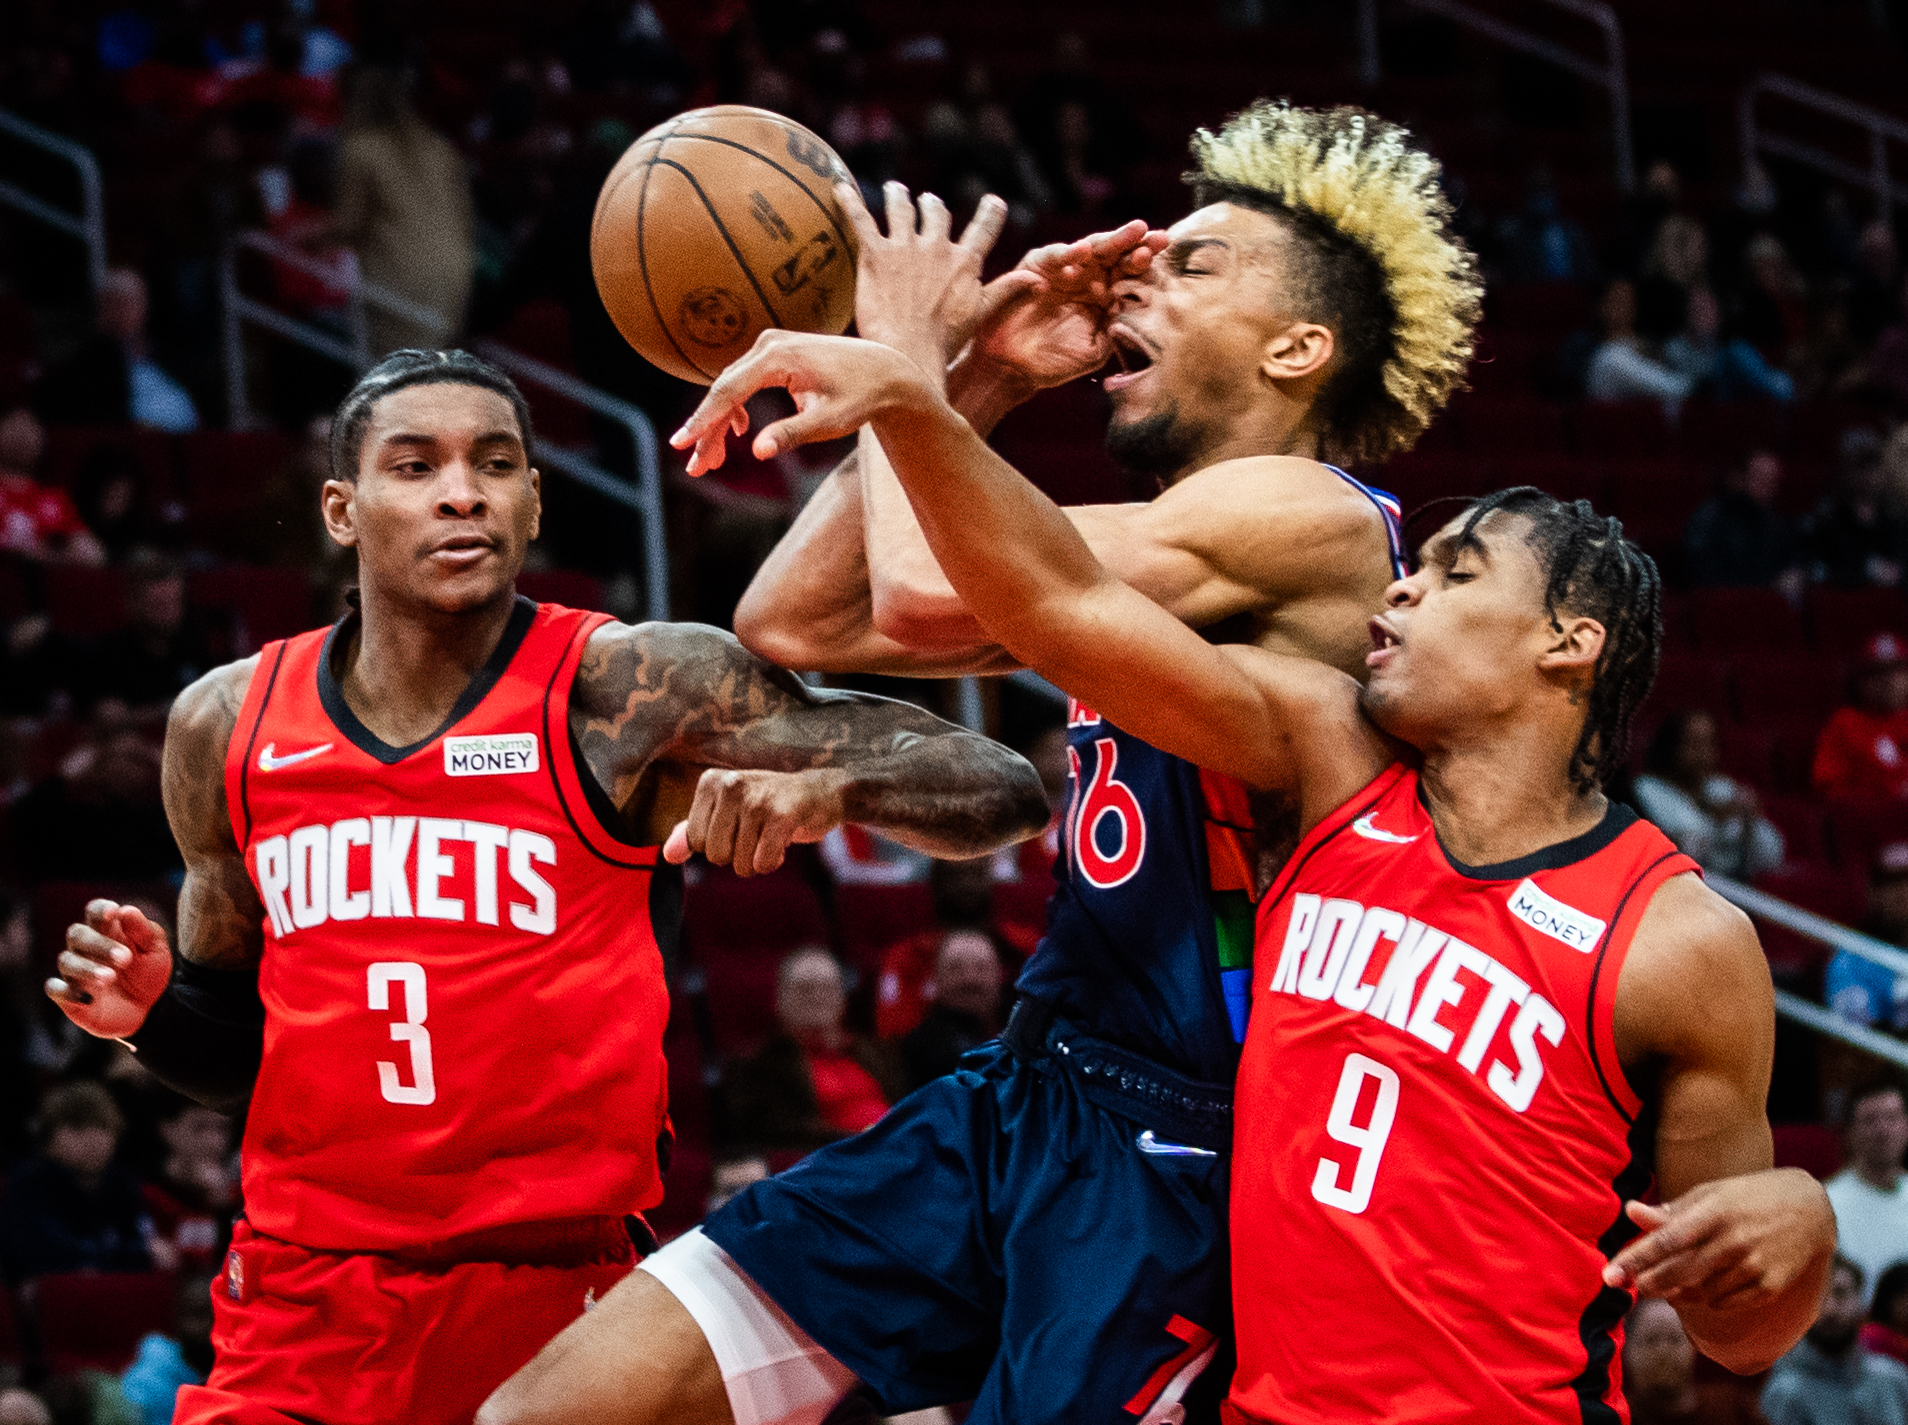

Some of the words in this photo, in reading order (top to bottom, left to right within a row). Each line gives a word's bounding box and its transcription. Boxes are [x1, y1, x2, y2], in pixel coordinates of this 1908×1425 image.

[451, 738, 486, 752] credit
[490, 738, 533, 751] karma
[452, 751, 531, 772] MONEY
[255, 815, 558, 939] ROCKETS
[1514, 896, 1592, 945] MONEY
[366, 961, 437, 1106] 3
[1269, 892, 1567, 1113] ROCKETS
[1311, 1052, 1401, 1215] 9
